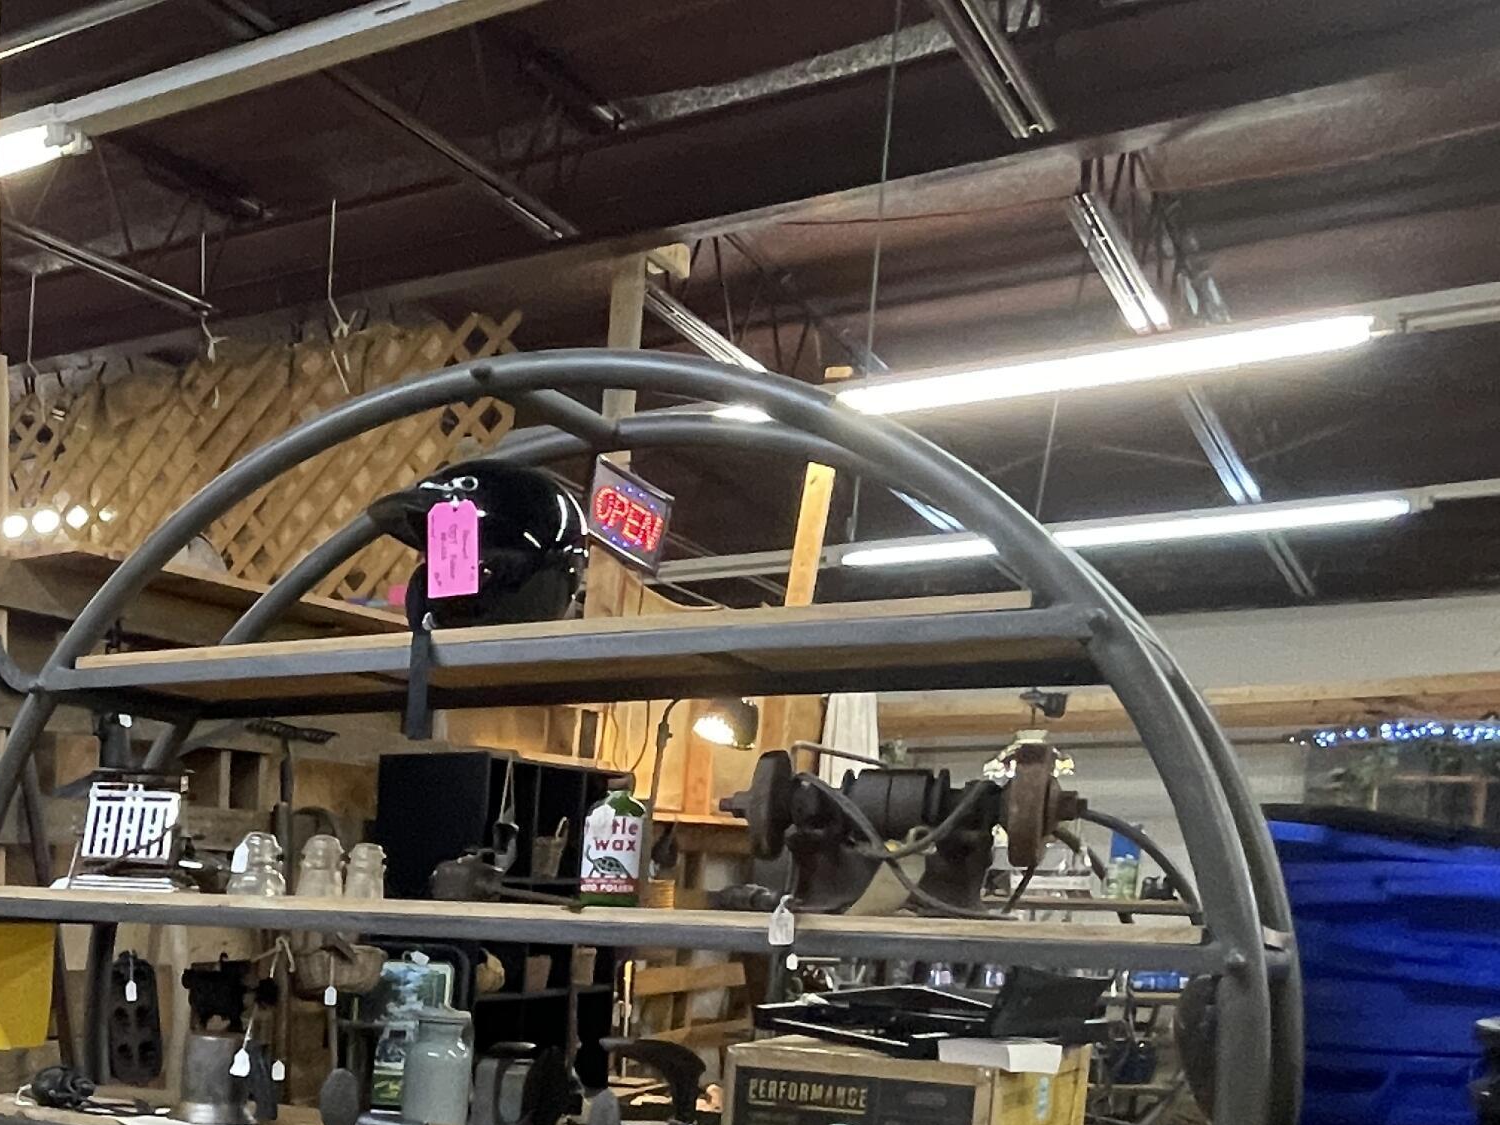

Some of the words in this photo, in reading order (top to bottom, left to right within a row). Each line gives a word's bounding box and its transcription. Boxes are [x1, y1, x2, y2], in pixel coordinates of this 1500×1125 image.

[595, 487, 663, 551] OPEN
[595, 839, 636, 852] wax
[748, 1077, 867, 1109] PERFORMANCE
